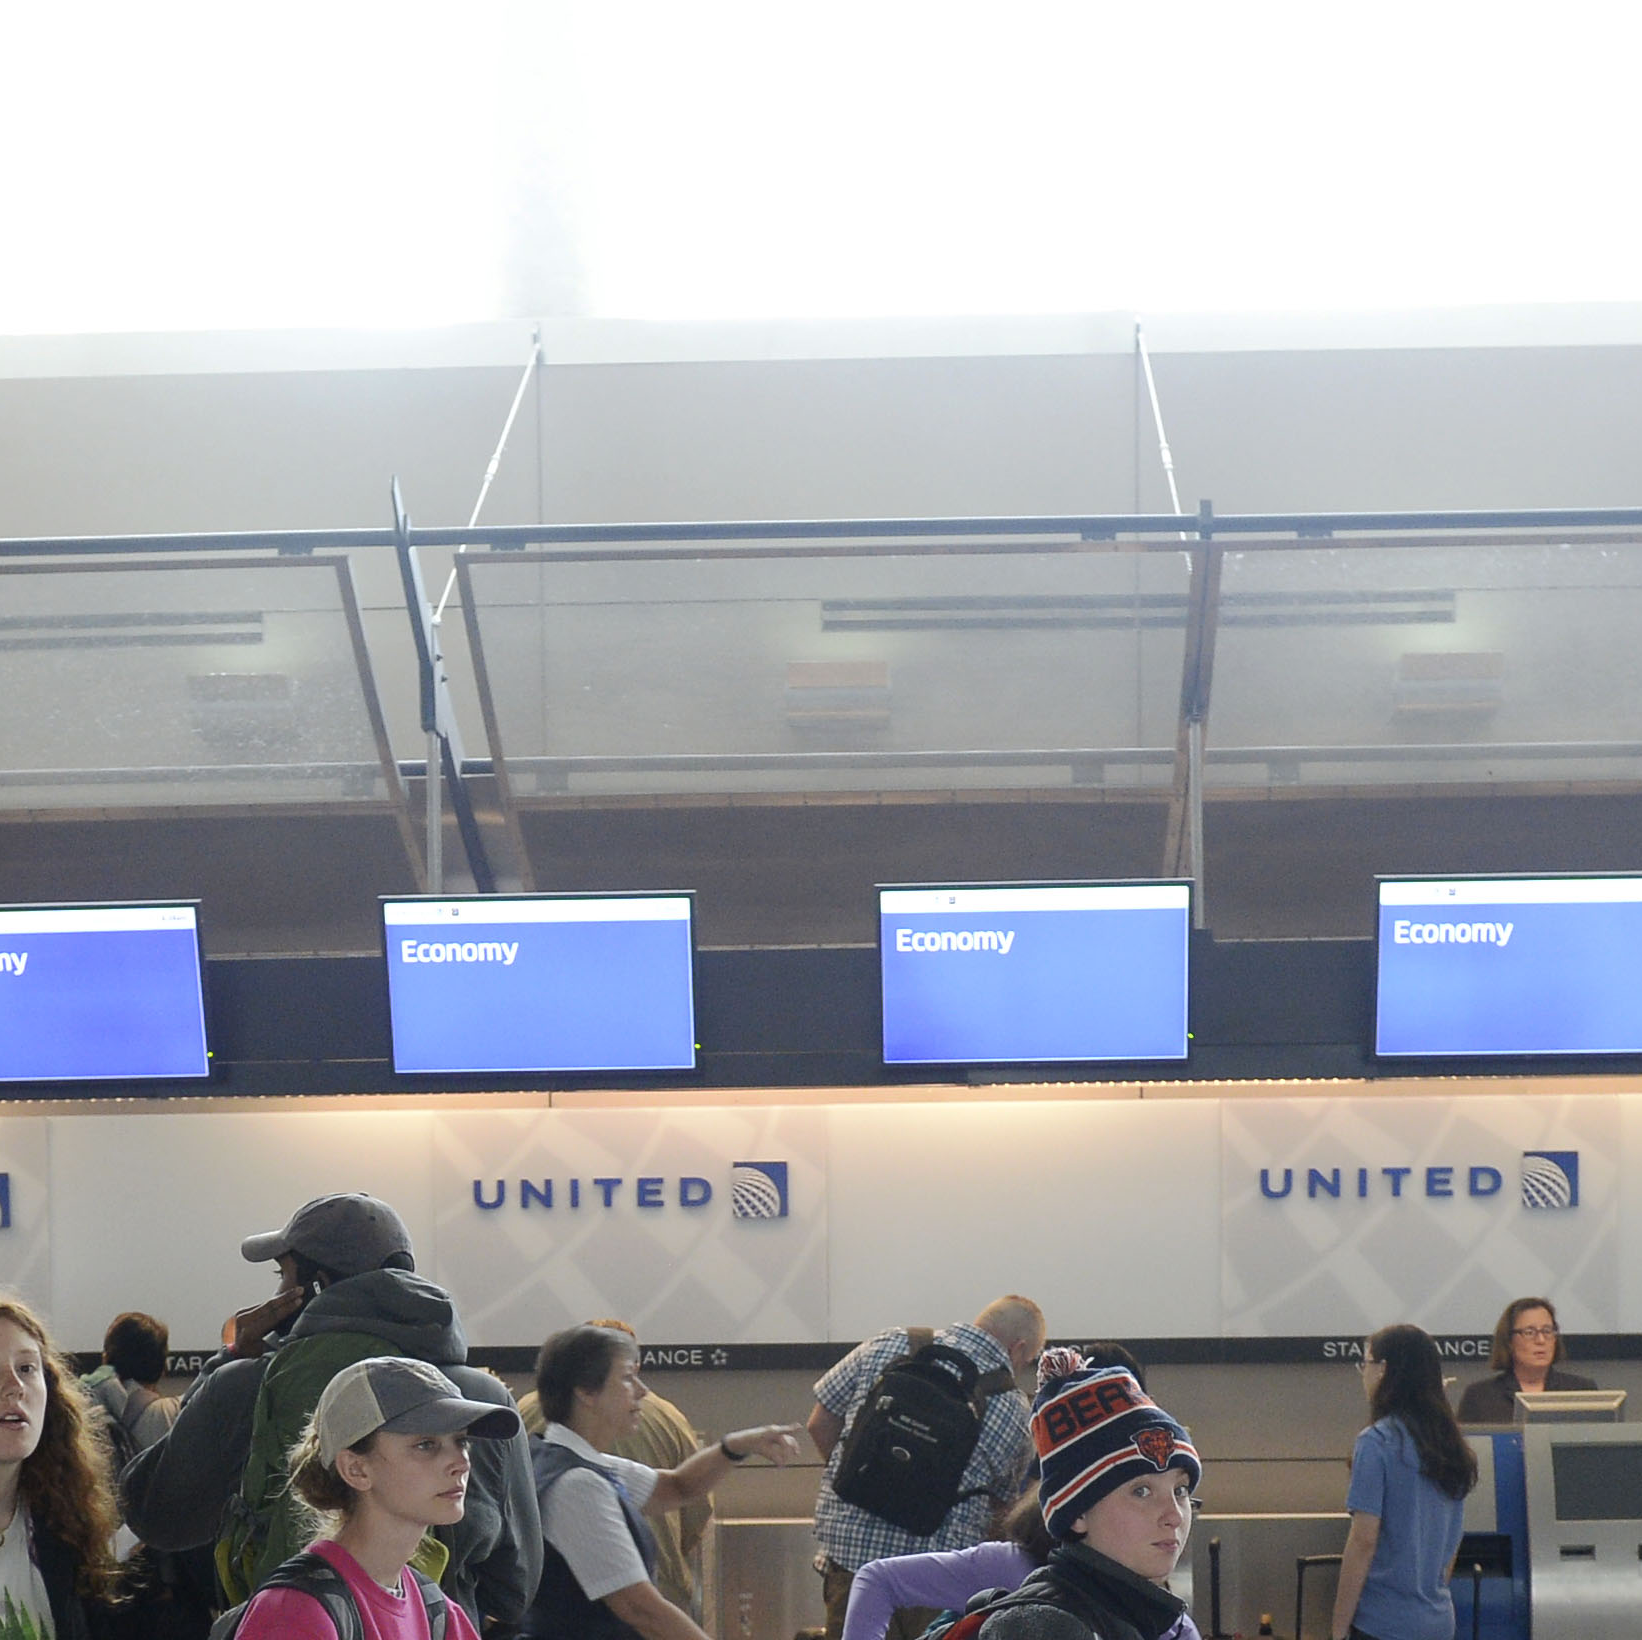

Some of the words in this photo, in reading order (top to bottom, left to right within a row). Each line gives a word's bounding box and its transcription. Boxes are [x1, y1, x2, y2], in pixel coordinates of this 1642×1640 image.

[896, 928, 1015, 955] Economy
[1394, 920, 1514, 947] Economy
[401, 940, 519, 966] Economy
[472, 1177, 713, 1212] UNITED
[1259, 1166, 1503, 1201] UNITED
[166, 1356, 203, 1371] TAR
[642, 1349, 704, 1365] ANCE
